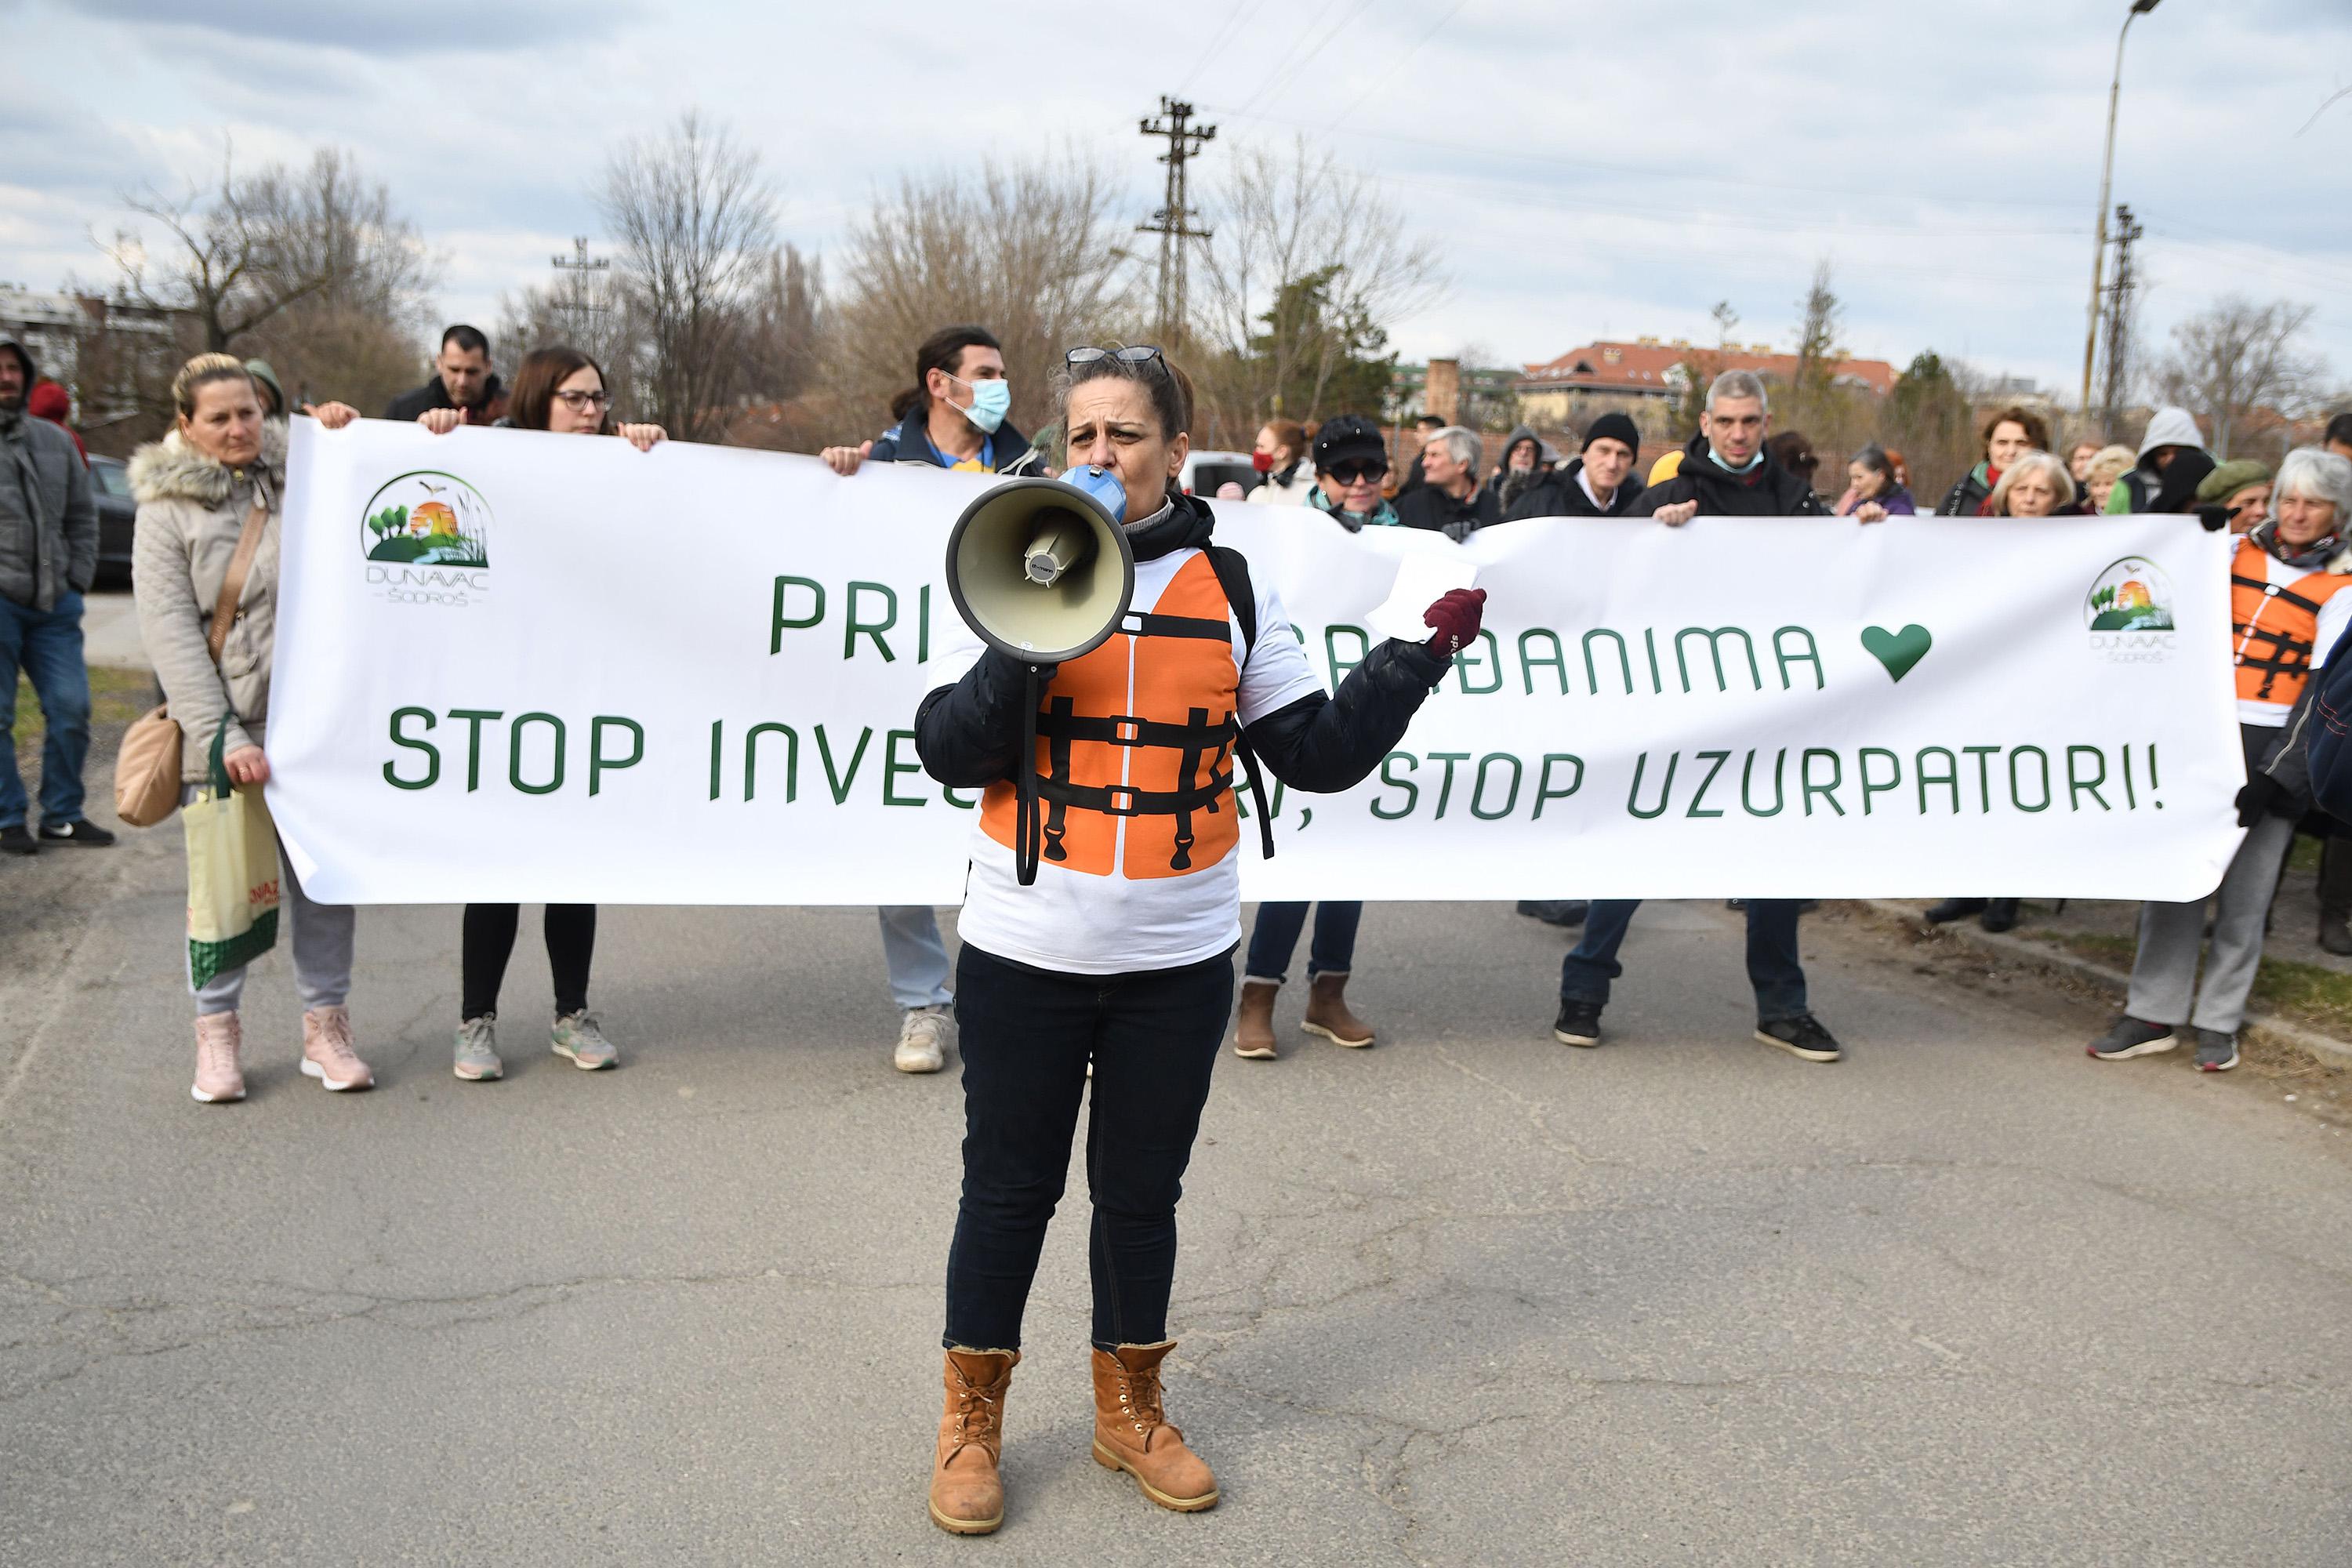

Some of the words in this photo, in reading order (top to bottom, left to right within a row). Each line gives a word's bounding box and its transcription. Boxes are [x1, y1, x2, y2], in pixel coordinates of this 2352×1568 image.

[365, 565, 489, 590] DUNAVAC
[383, 706, 644, 797] STOP
[1370, 752, 1584, 821] STOP
[1628, 742, 2164, 819] UZURPATORI!
